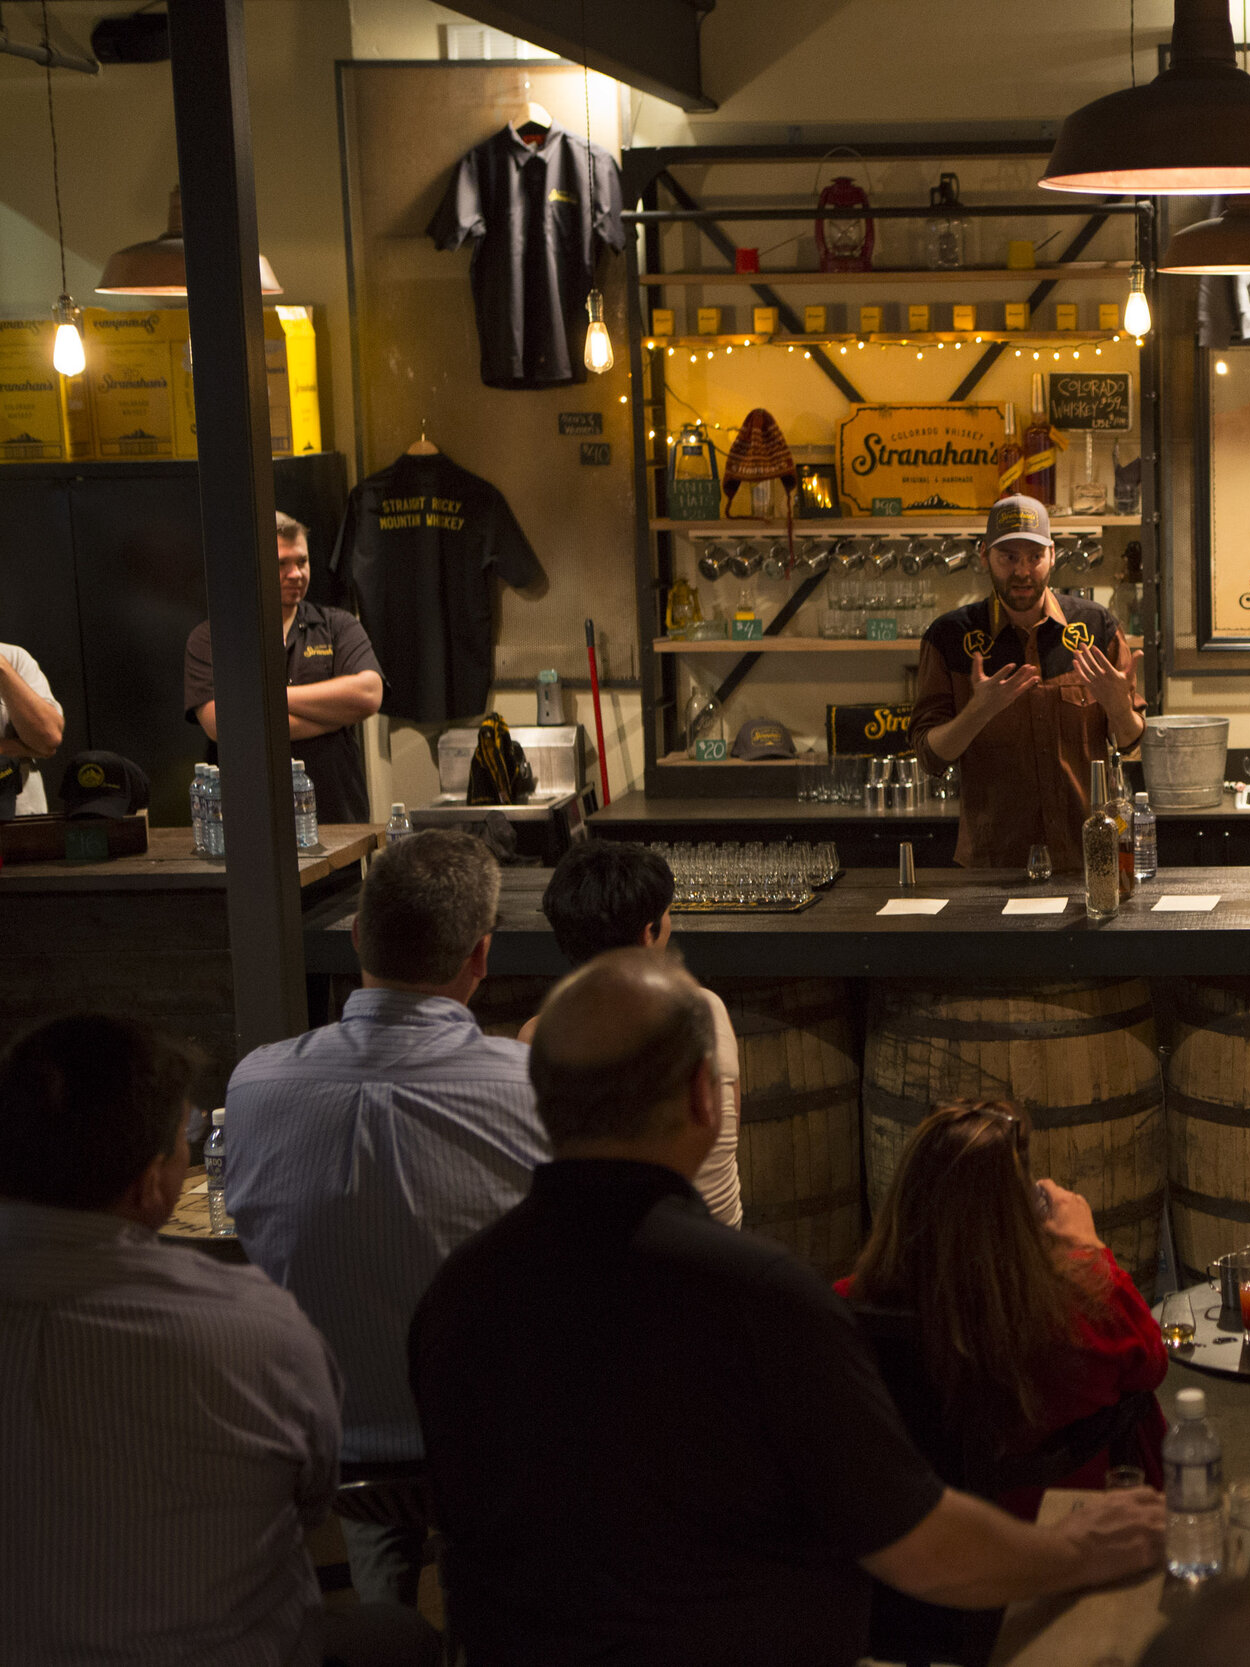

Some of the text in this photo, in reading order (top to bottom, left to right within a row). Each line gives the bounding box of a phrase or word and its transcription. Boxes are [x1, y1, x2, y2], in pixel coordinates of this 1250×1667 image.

[1058, 378, 1125, 397] COLORADO
[891, 427, 985, 442] COLORADO WHISKEY
[852, 432, 999, 477] Stranahan's
